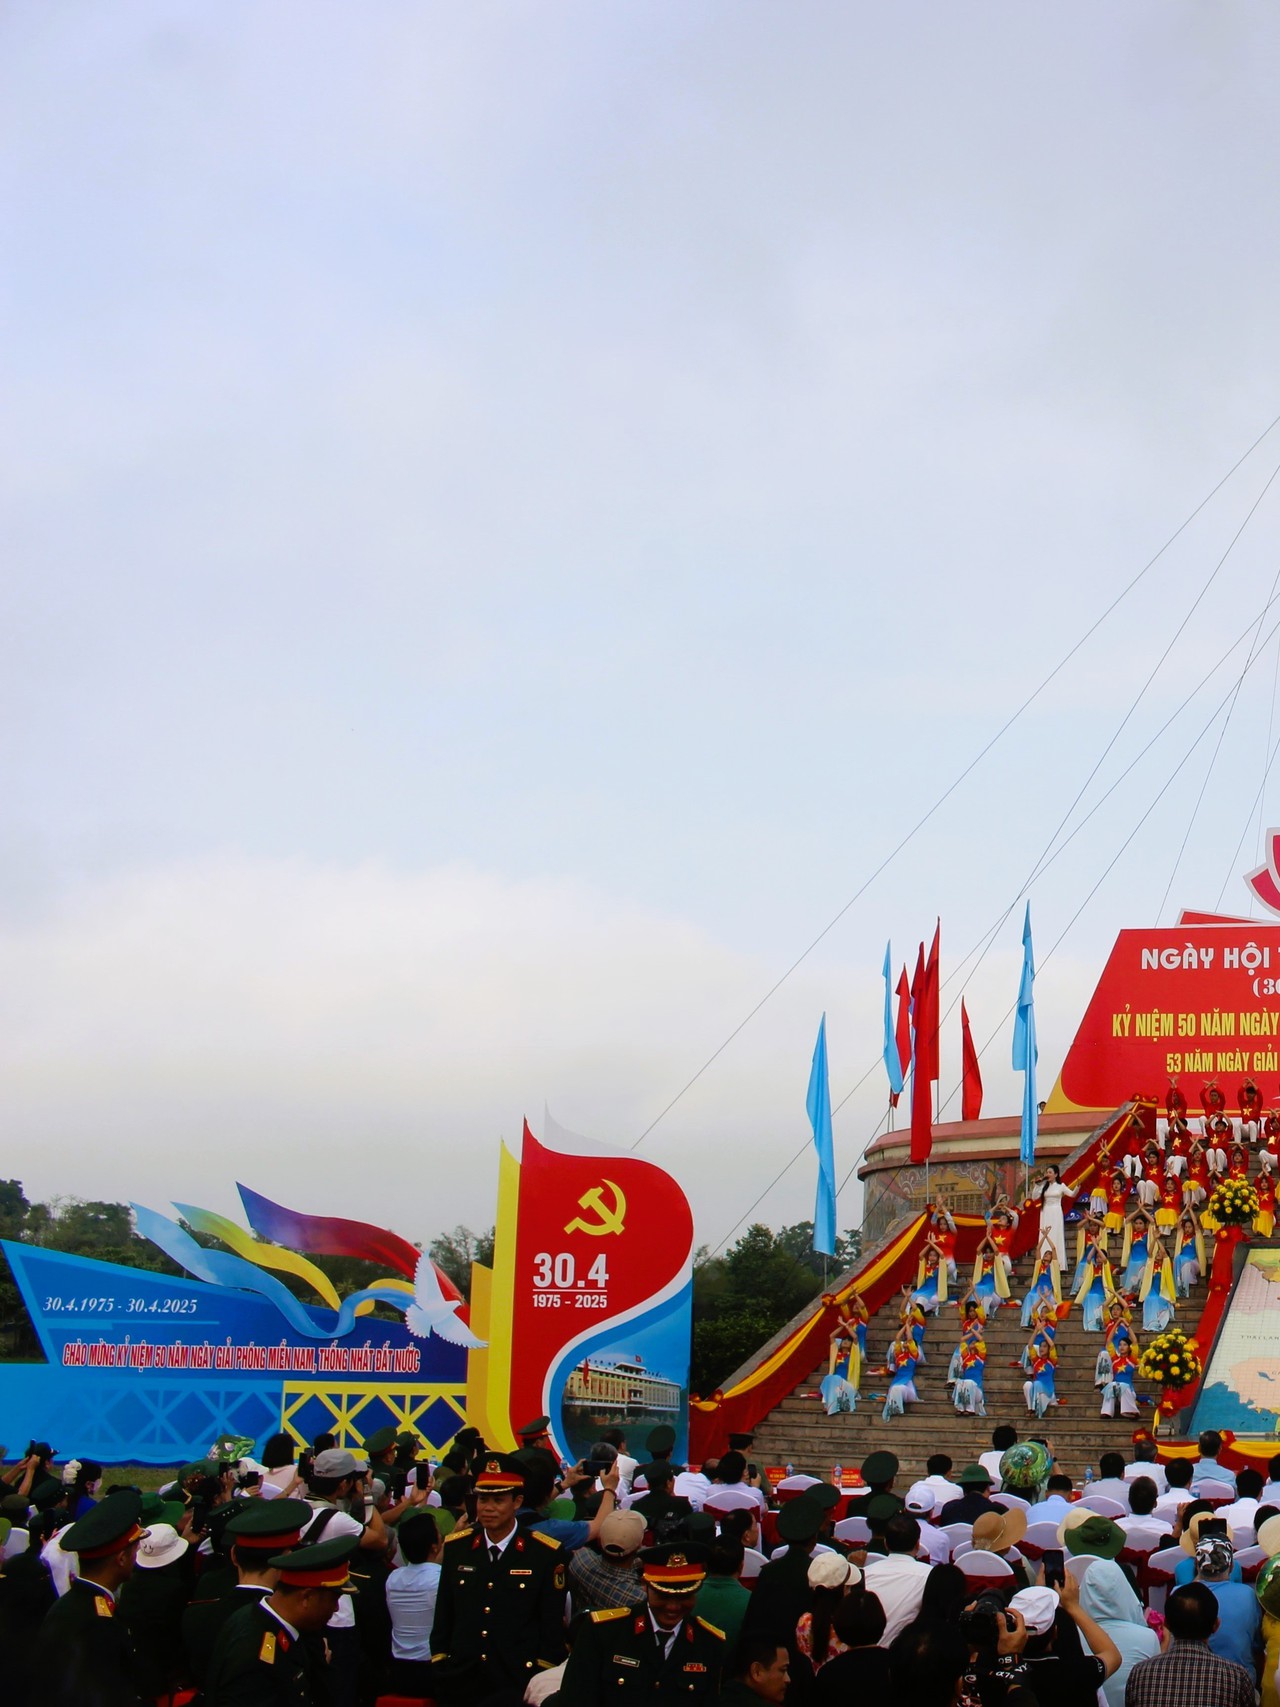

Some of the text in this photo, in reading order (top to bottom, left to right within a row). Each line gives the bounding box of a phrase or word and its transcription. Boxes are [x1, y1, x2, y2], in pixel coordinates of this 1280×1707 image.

[1141, 943, 1215, 970] NGÀY
[1224, 941, 1270, 976] HỘI
[1112, 1004, 1131, 1037] KỶ
[1135, 1009, 1174, 1042] NIỆM
[1178, 1014, 1196, 1036] 50
[1200, 1008, 1235, 1036] NĂM
[1240, 1007, 1280, 1036] NGÀY
[1166, 1054, 1182, 1073] 53
[1185, 1049, 1213, 1072] NĂM
[1217, 1049, 1250, 1072] NGÀY
[1253, 1044, 1278, 1072] GIẢI
[532, 1252, 609, 1287] 30.4
[43, 1297, 115, 1312] 30.4.1975
[126, 1298, 197, 1314] 30.4.2025
[532, 1294, 561, 1307] 1975
[574, 1294, 607, 1308] 2025
[63, 1335, 421, 1374] CHÀO MỪNG KỶ NIỆM 50 NĂM NGÀY GIẢI PHÓNG MIỀN NAM, THỐNG NHẤT ĐẤT NƯỚC
